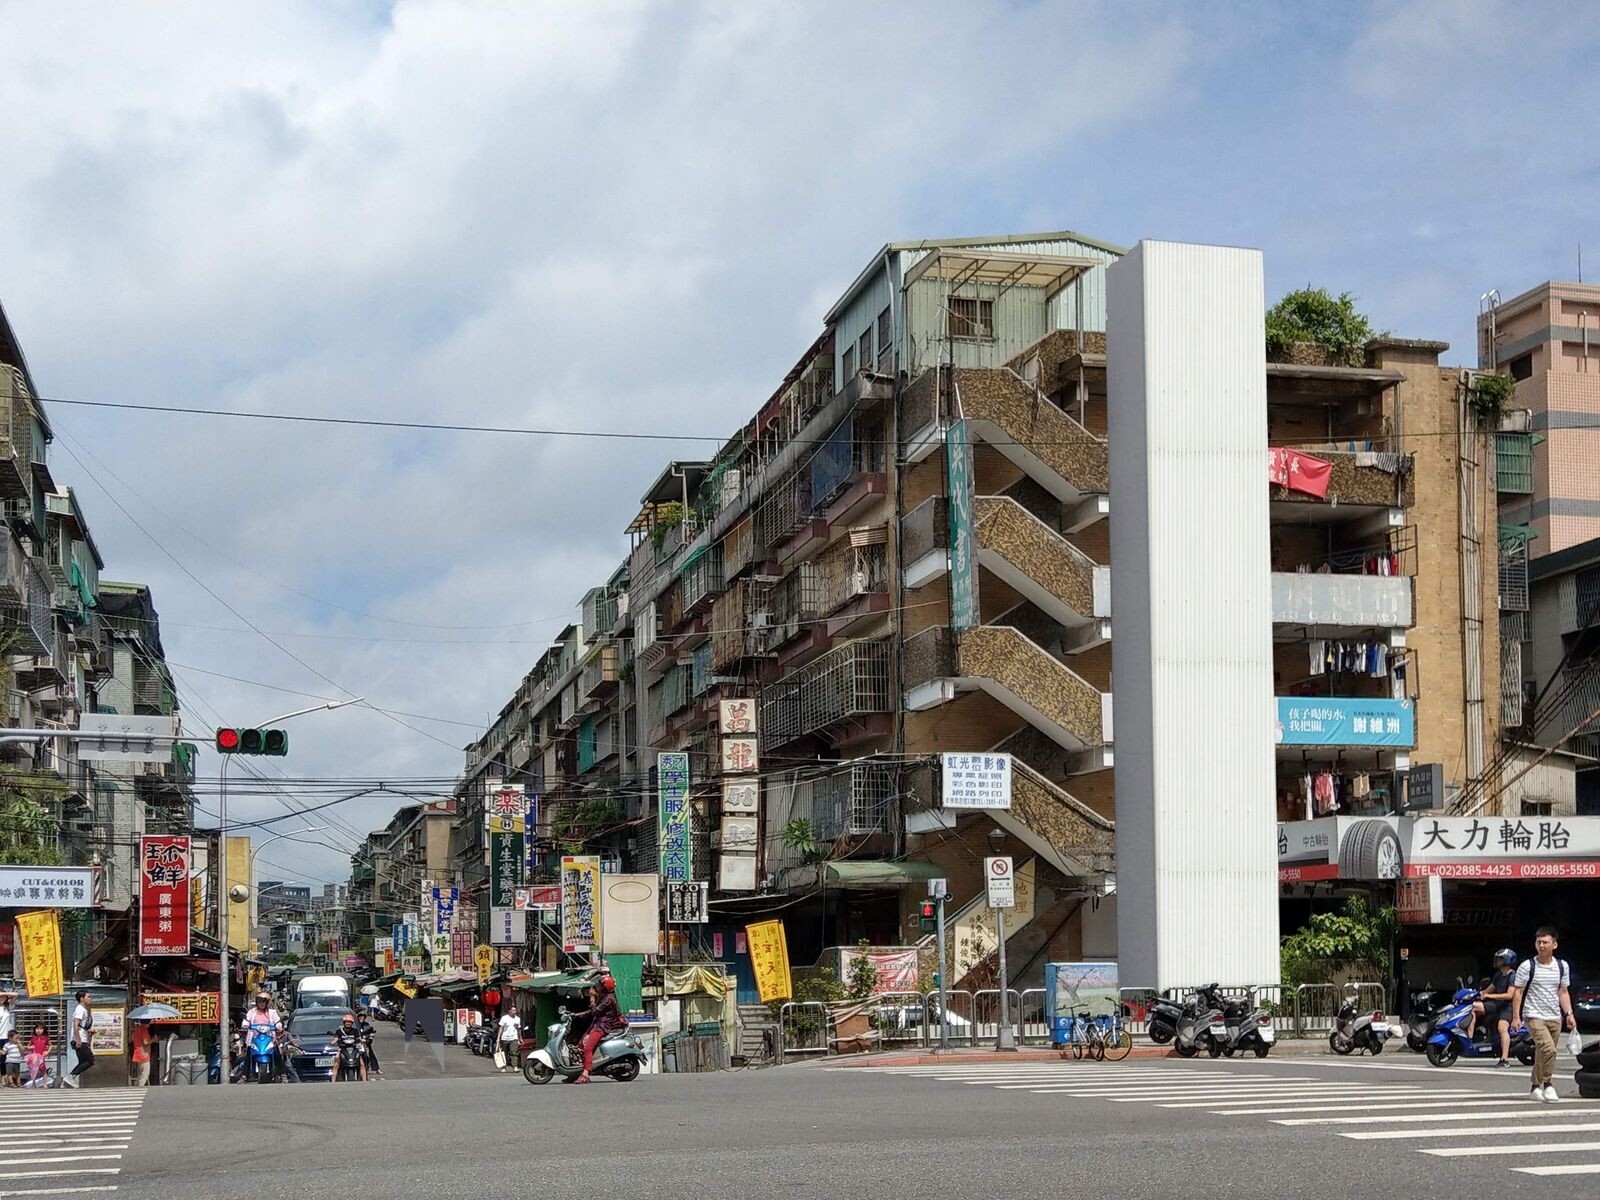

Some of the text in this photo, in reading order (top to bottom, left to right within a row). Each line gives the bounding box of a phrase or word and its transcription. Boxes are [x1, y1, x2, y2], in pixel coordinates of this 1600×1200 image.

[662, 755, 684, 769] 秀才
[1420, 819, 1571, 853] 大力輪胎
[498, 833, 515, 906] 資生堂藥局
[1520, 864, 1596, 876] (02)2885-5550
[22, 878, 85, 887] CUT&COLOR
[671, 884, 699, 892] PCO
[159, 893, 172, 932] 廣東粥
